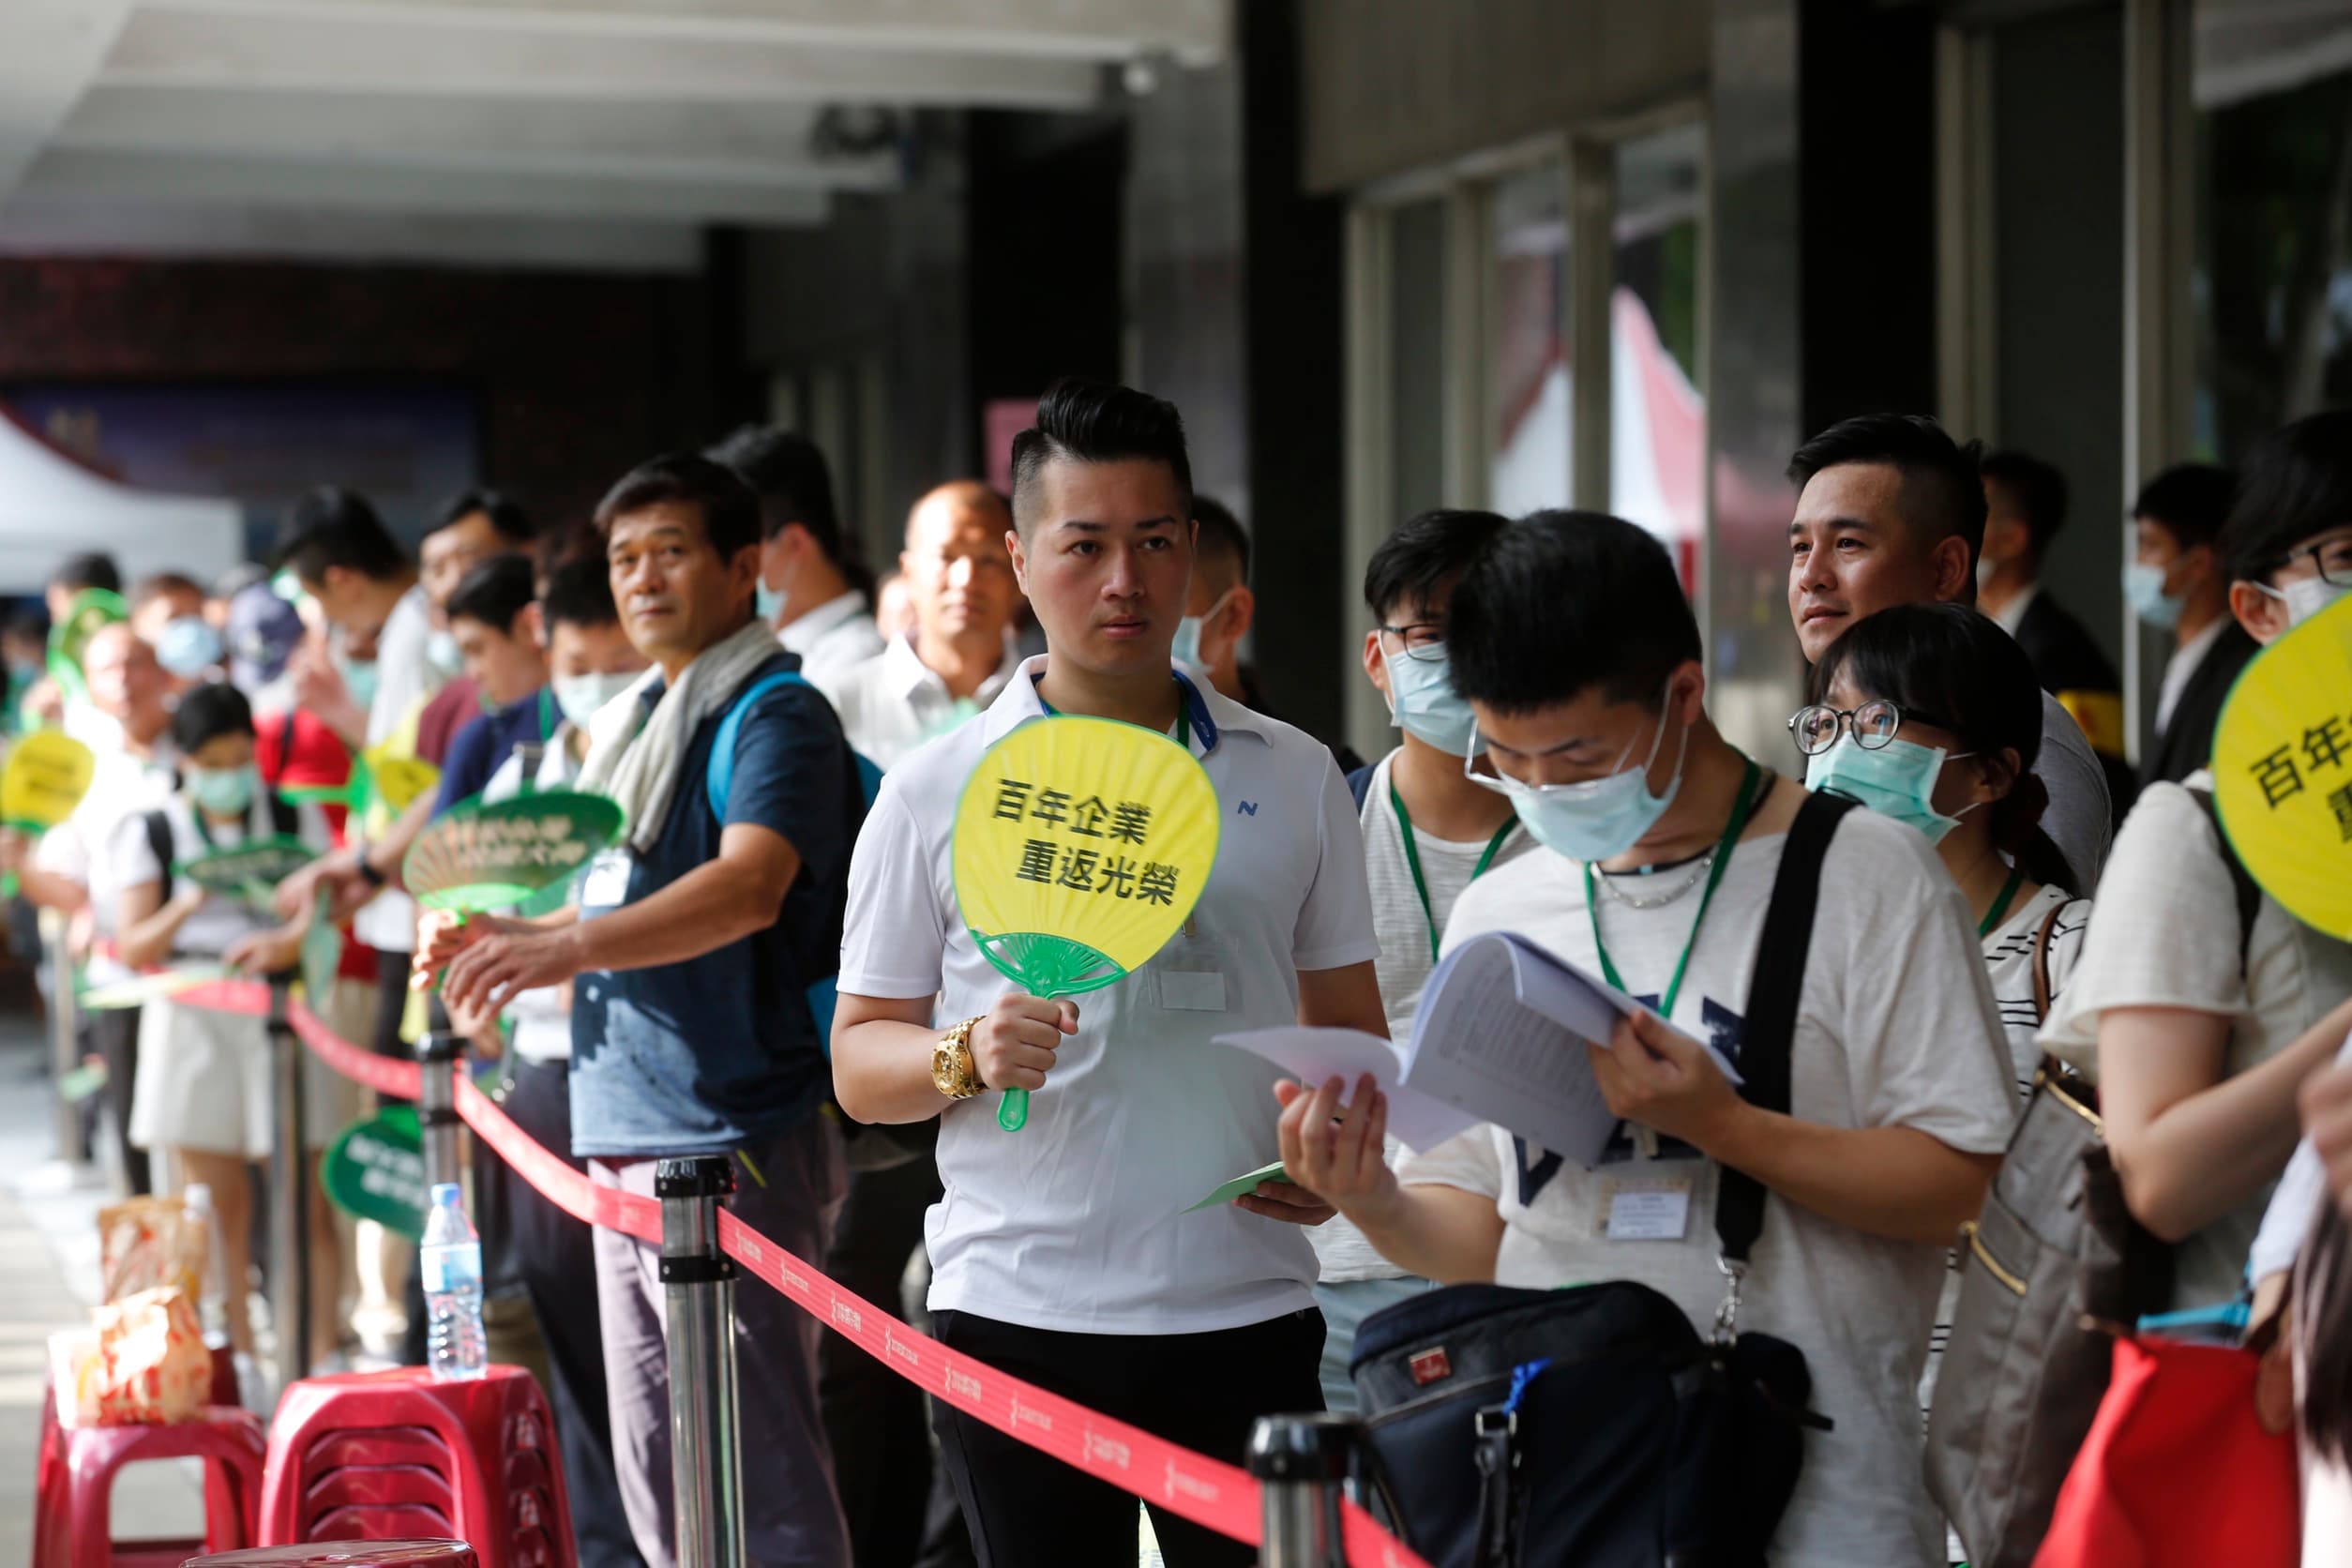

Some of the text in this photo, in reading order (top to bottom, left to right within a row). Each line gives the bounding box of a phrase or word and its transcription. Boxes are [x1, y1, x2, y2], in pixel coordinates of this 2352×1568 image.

[2248, 715, 2352, 810] 百年
[992, 777, 1152, 846] 百年企業
[1015, 838, 1180, 907] 重返光榮
